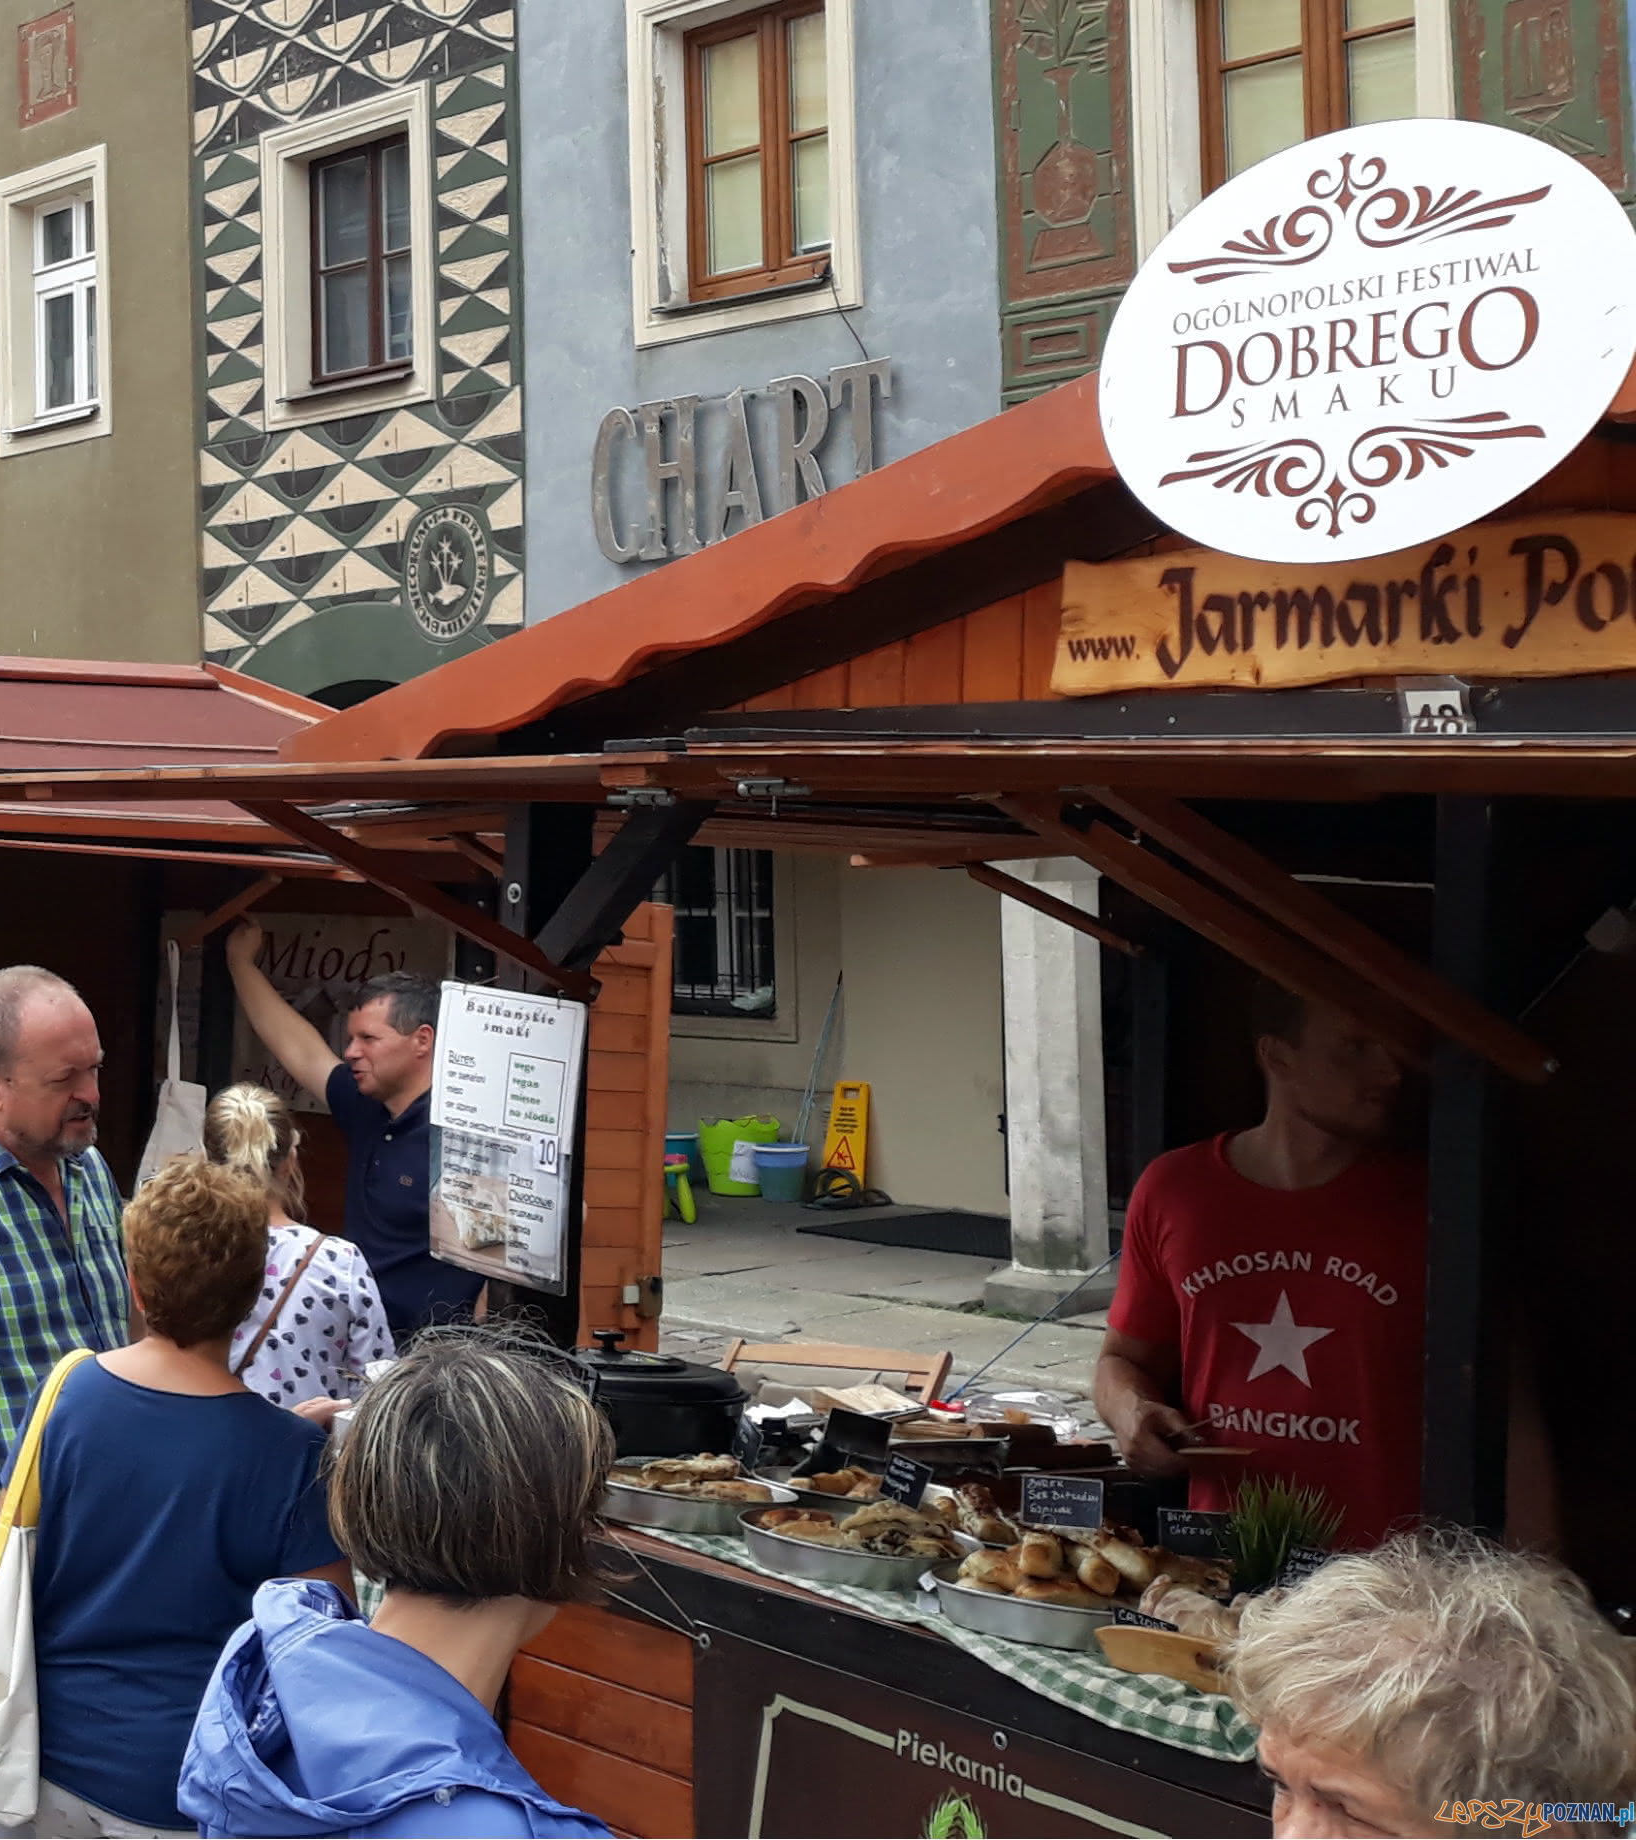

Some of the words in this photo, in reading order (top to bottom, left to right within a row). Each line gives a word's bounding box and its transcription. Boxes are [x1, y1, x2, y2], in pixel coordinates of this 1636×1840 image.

[1172, 275, 1384, 335] OGÓLNOPOLSKI
[1396, 248, 1540, 296] FESTIWAL
[1168, 285, 1541, 420] DOBREGO
[1230, 365, 1457, 429] SMAKU
[591, 355, 892, 564] CHART
[1067, 634, 1141, 662] www.
[1155, 543, 1483, 680] Jarmarki
[1502, 533, 1636, 650] Po
[255, 928, 407, 984] Miody
[539, 1138, 556, 1166] 10
[1180, 1250, 1313, 1298] KHAOSAN
[1323, 1255, 1399, 1306] ROAD
[1208, 1402, 1361, 1445] BANGKOK
[896, 1727, 1024, 1800] Piekarnia
